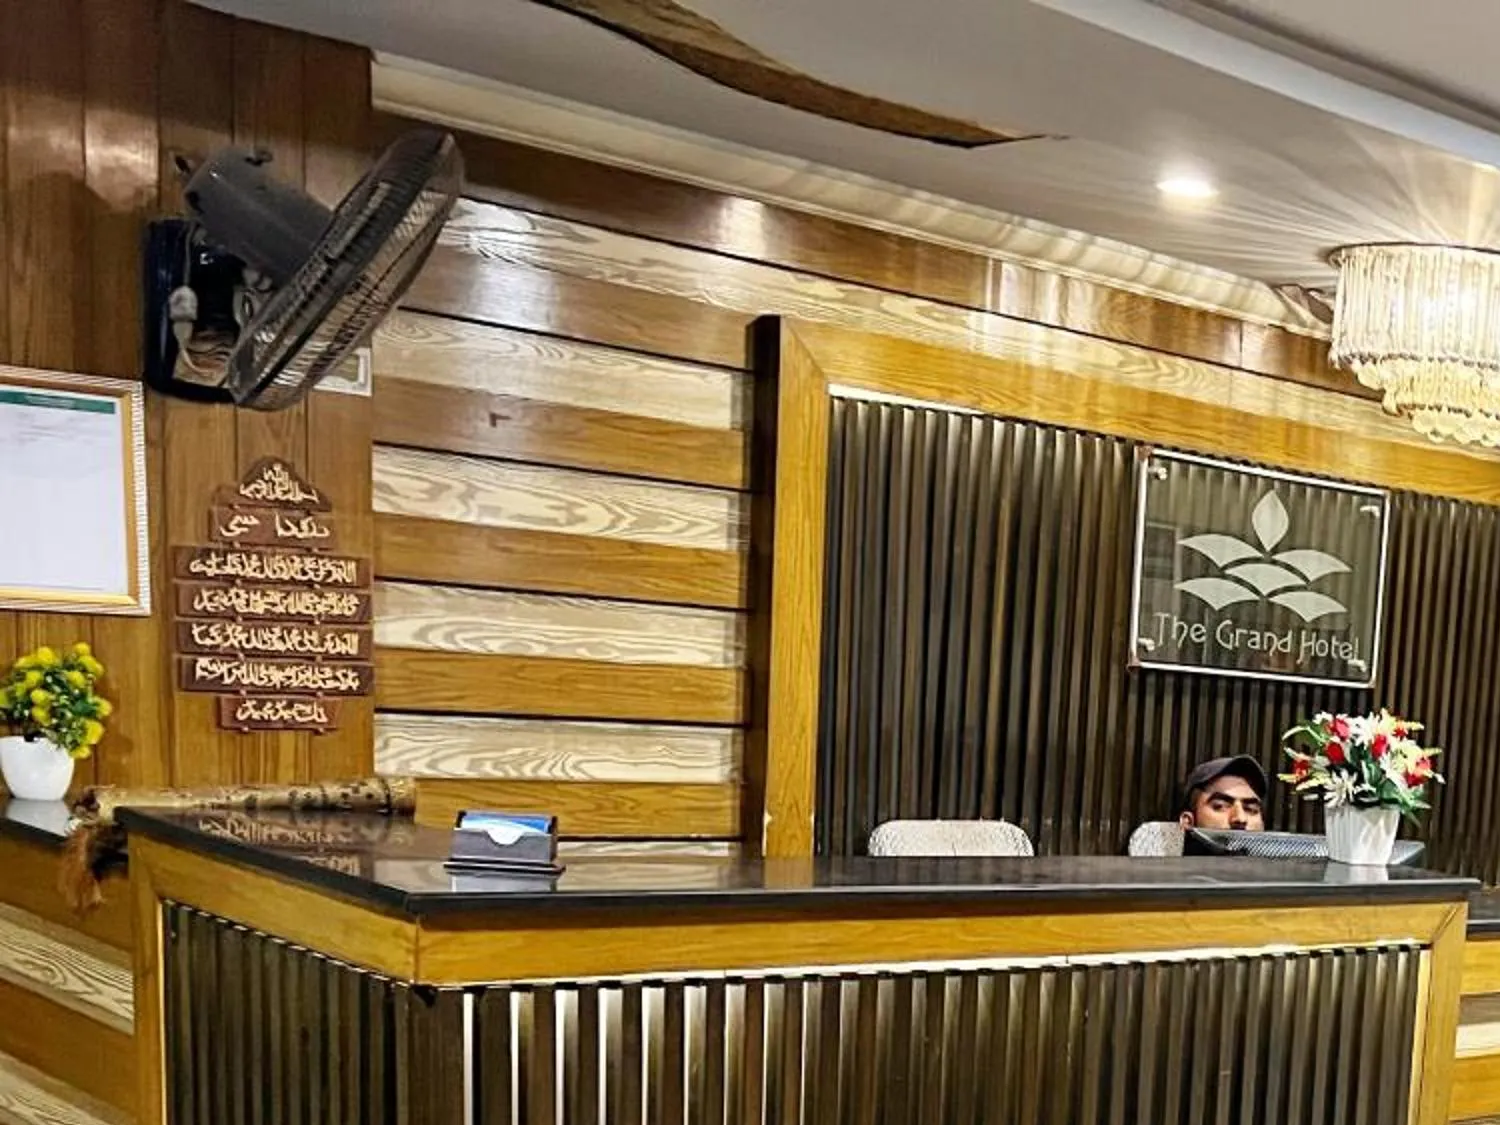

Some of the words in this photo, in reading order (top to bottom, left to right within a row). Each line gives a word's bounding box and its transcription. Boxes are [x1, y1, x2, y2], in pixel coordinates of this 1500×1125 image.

[1153, 612, 1207, 648] The
[1215, 619, 1293, 657] Grand
[1296, 630, 1360, 665] Hotel
